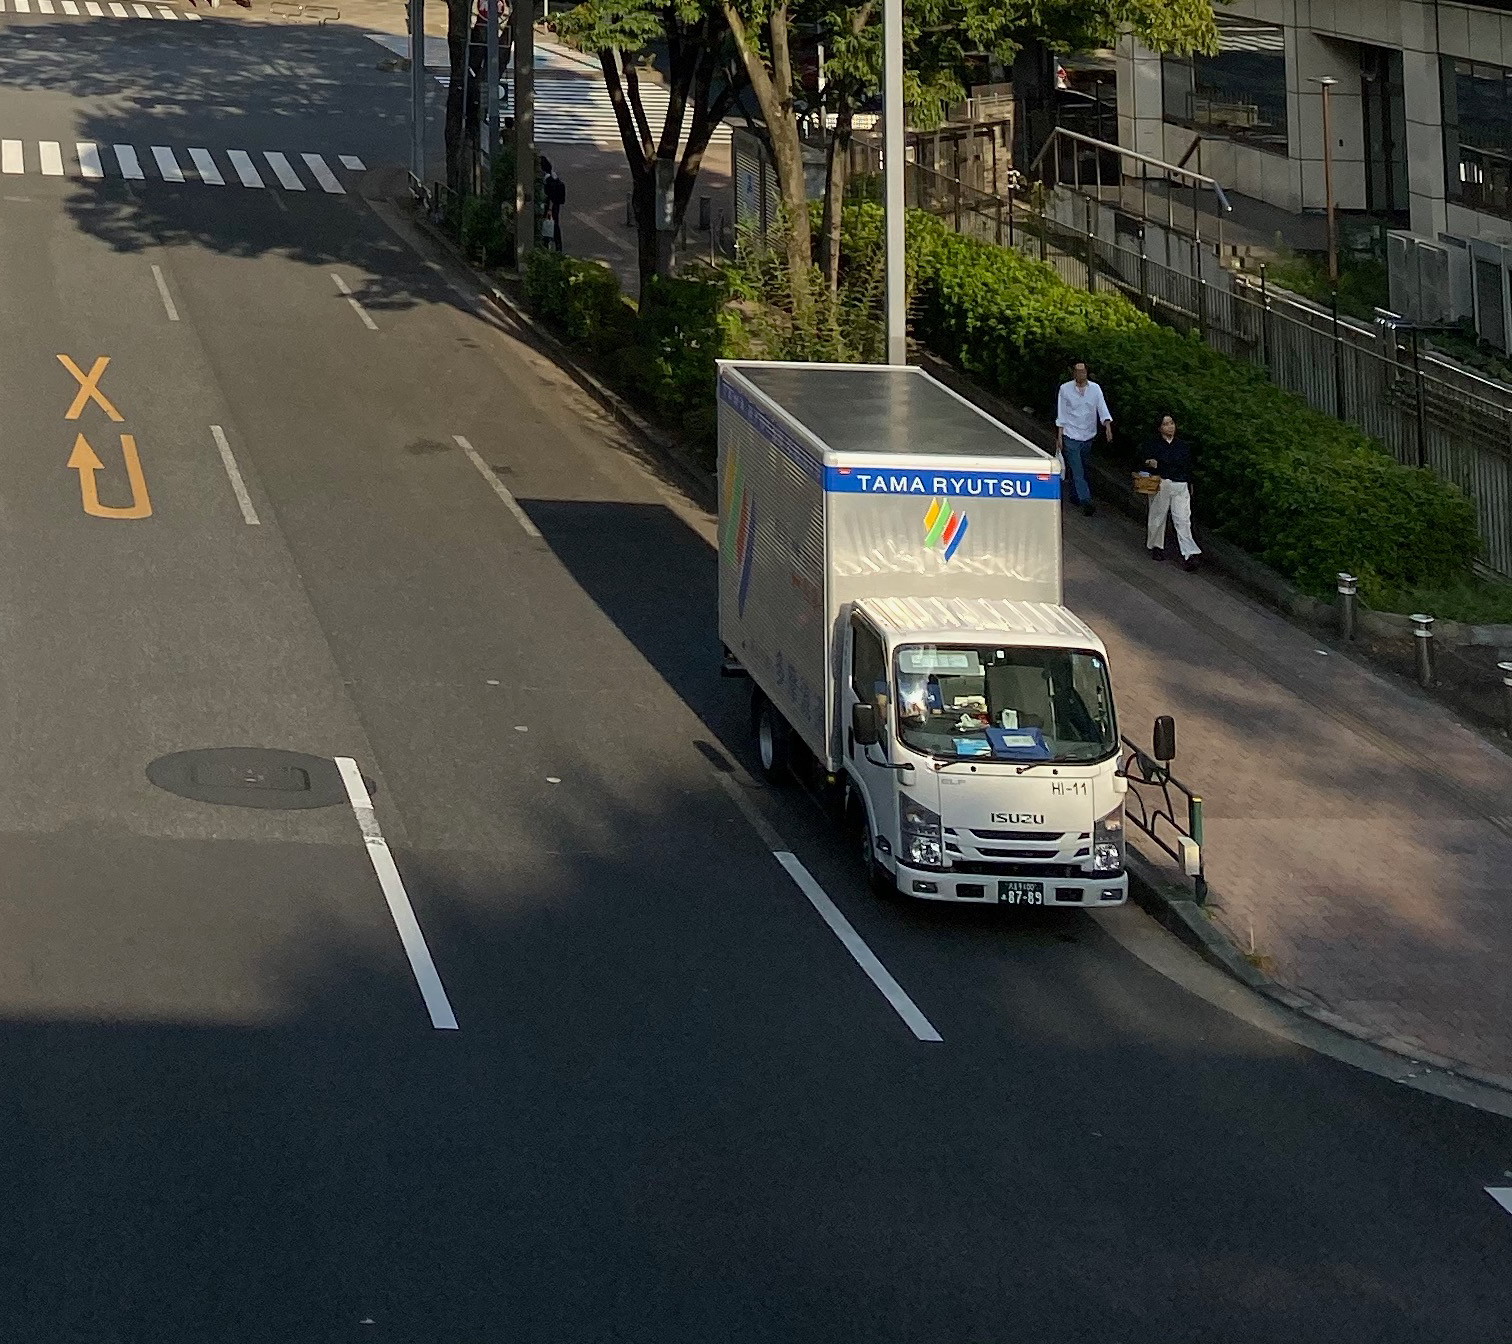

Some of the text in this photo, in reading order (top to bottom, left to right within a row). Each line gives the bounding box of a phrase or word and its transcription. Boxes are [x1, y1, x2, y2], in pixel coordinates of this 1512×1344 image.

[857, 474, 1031, 497] TAMA RYUTSU
[1052, 782, 1087, 796] HI-11
[990, 812, 1045, 825] ISUZU
[1008, 891, 1043, 905] 87-89
